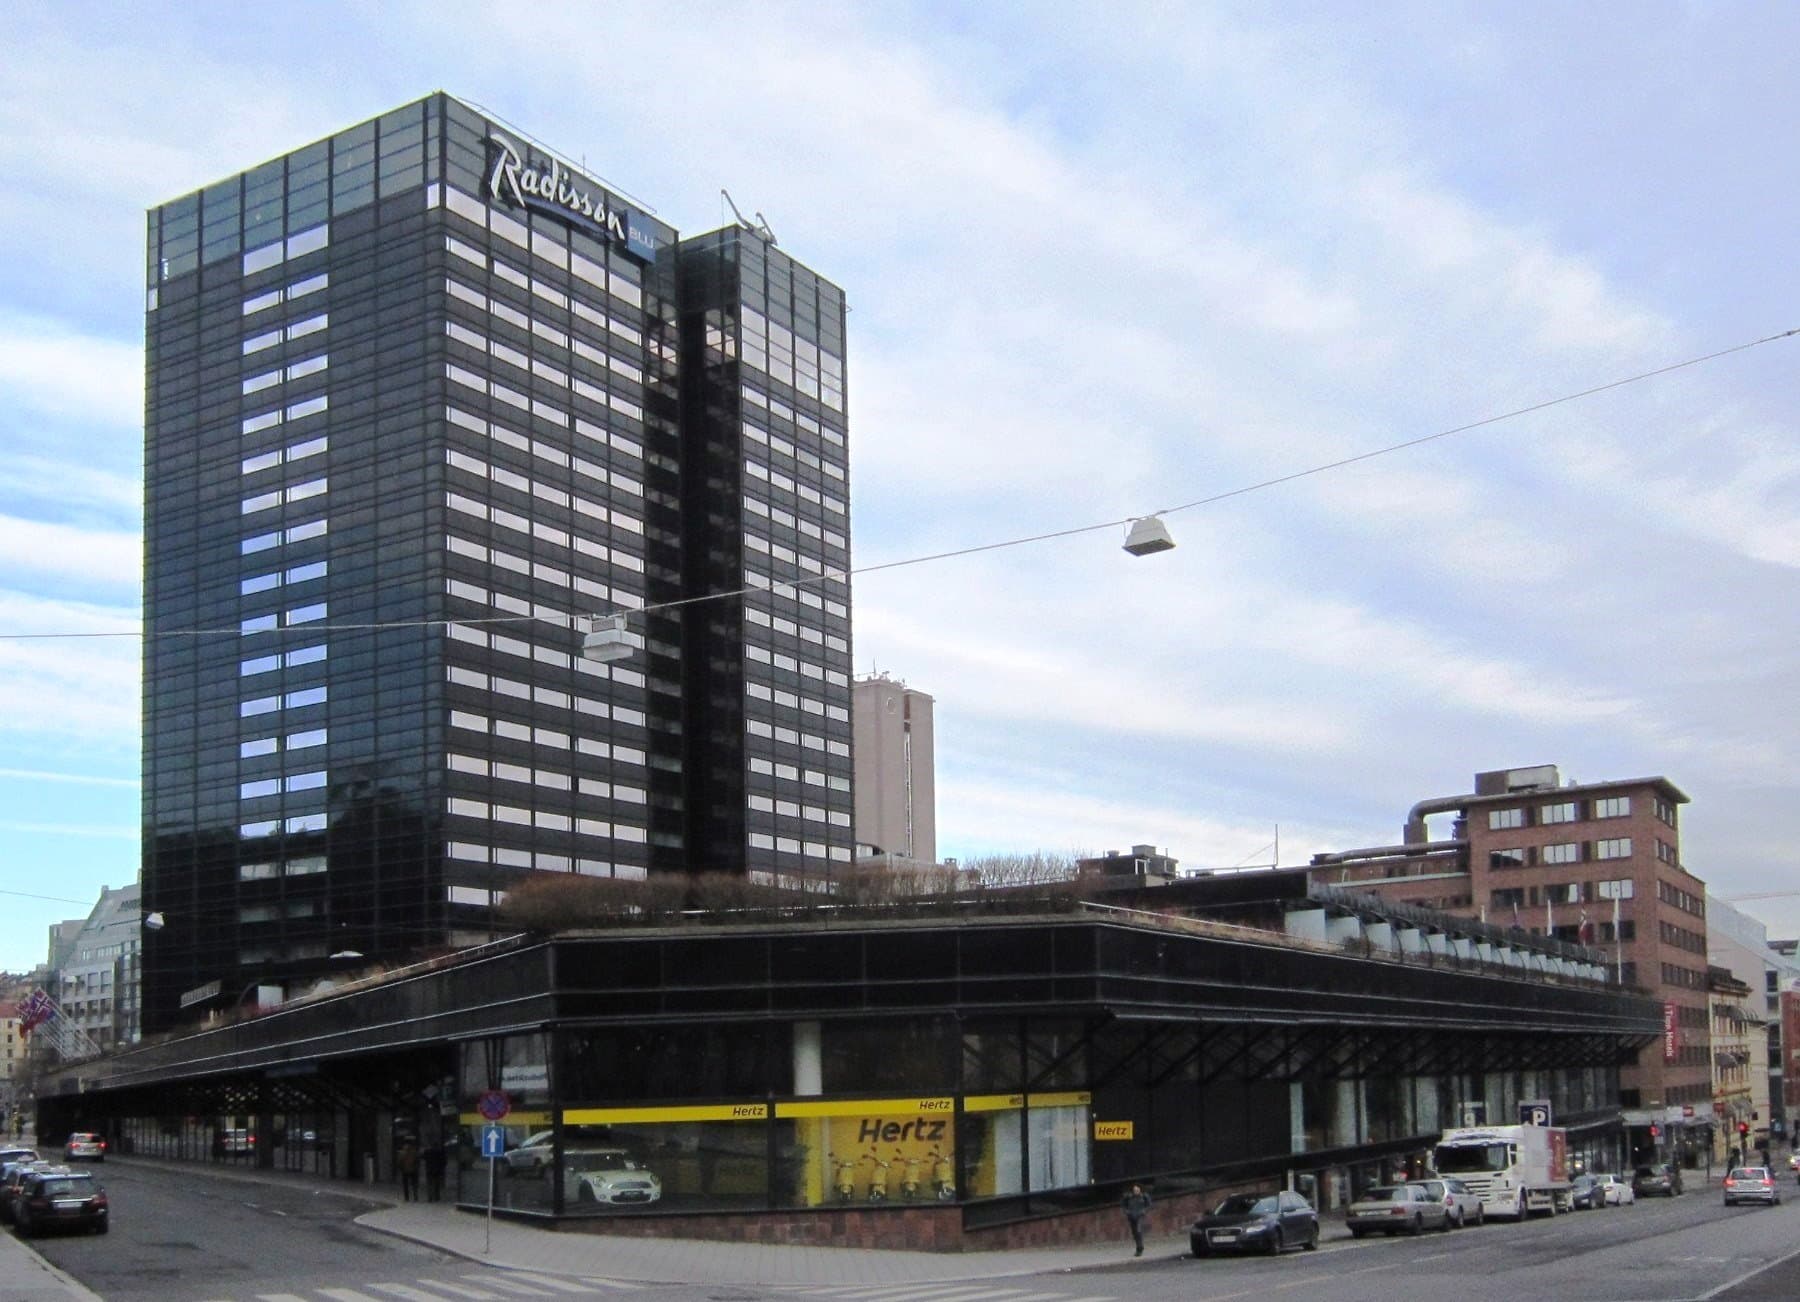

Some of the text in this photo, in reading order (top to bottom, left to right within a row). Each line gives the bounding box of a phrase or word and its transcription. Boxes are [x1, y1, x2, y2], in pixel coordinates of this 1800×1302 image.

[489, 133, 626, 241] Radisson
[732, 1106, 764, 1116] Hertz
[919, 1099, 951, 1110] Hertz
[1533, 1109, 1546, 1127] P
[858, 1116, 947, 1143] Hertz
[1097, 1125, 1127, 1137] Hertz
